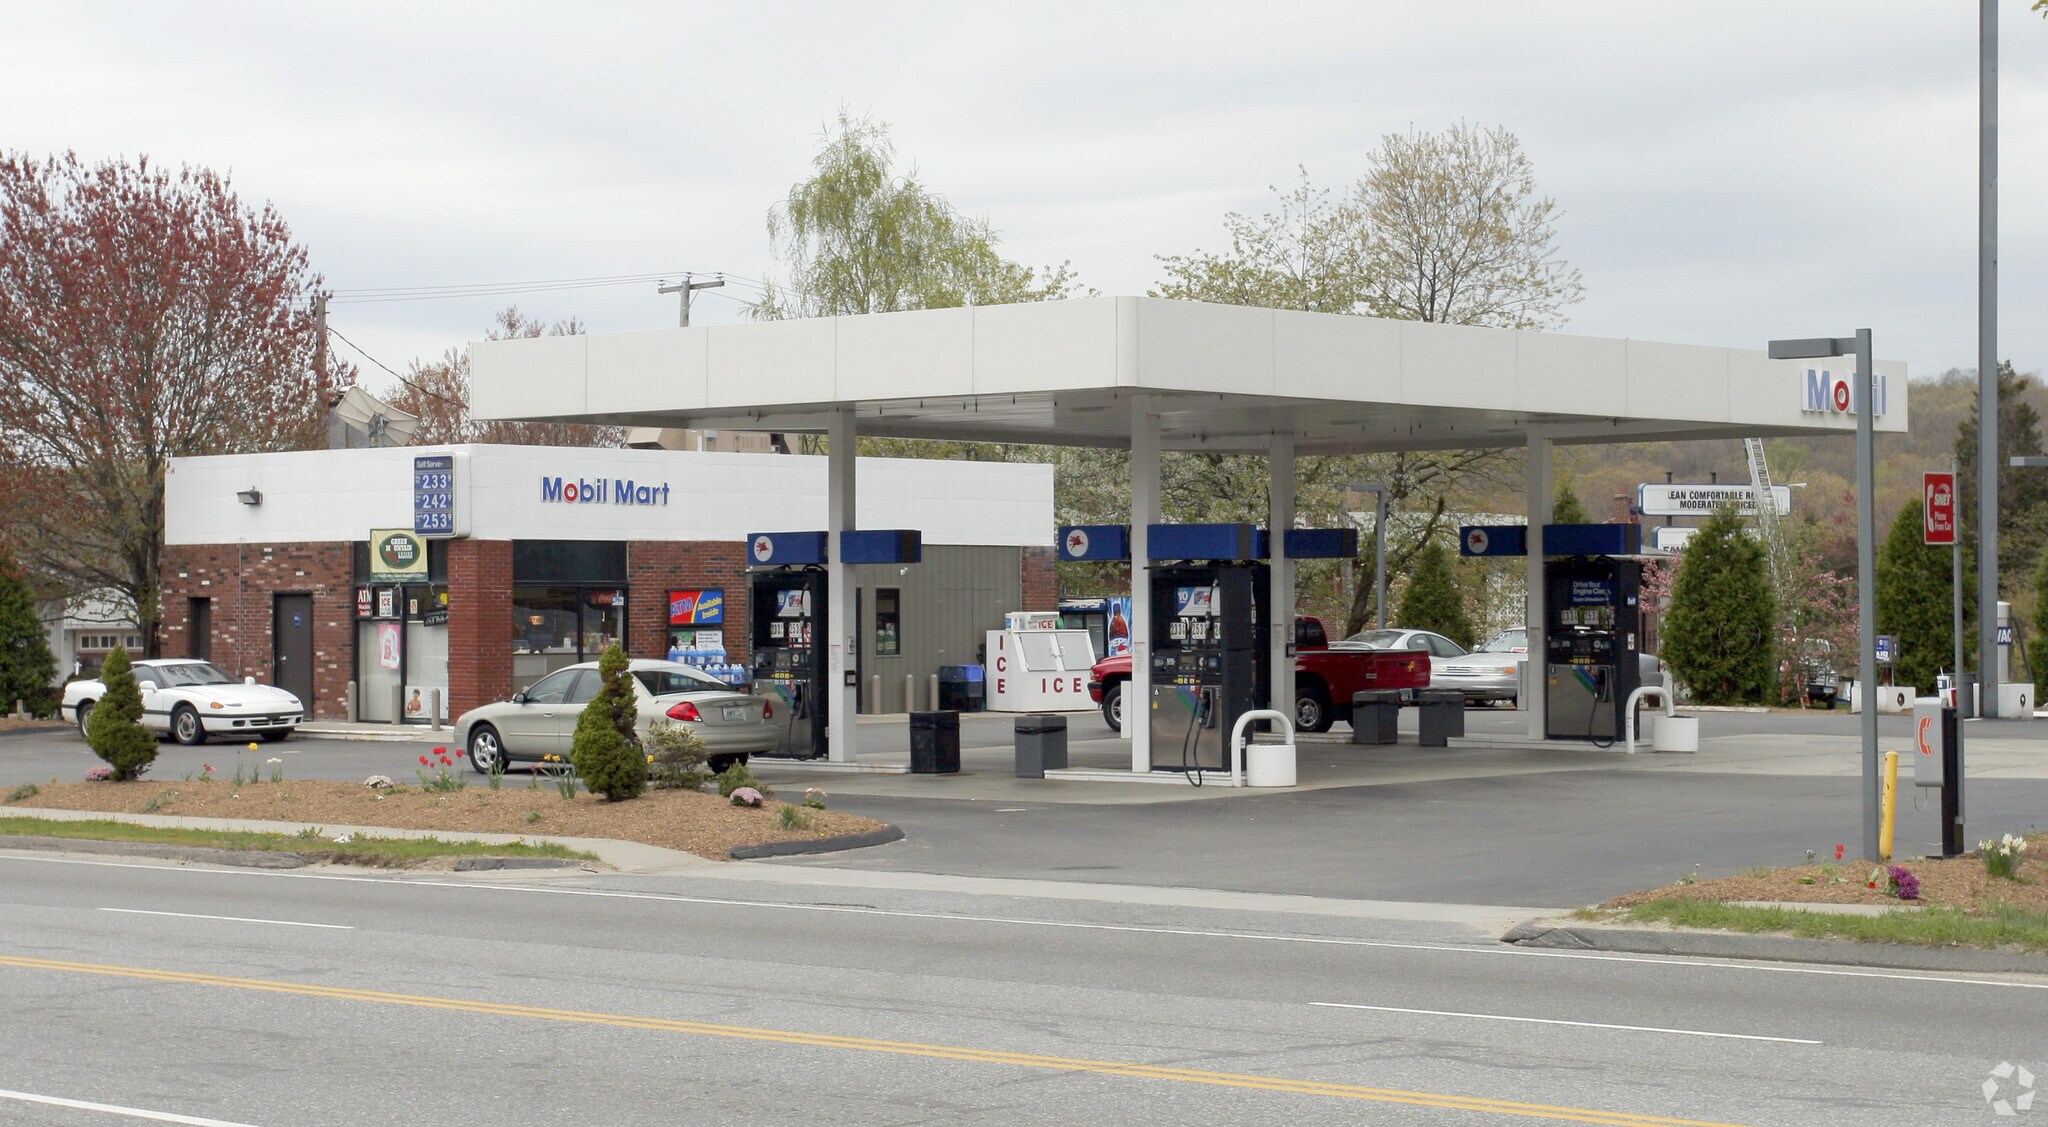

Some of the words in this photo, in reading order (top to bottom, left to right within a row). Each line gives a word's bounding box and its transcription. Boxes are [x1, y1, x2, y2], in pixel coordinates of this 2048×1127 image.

[542, 476, 608, 502] Mobil
[615, 479, 670, 505] Mart
[1689, 491, 1743, 500] COMFORTABLE
[1178, 591, 1188, 601] 10
[671, 597, 694, 617] ATM
[698, 597, 722, 611] Available
[702, 608, 719, 619] Inside
[1038, 620, 1054, 629] ICE
[1042, 677, 1082, 693] ICE
